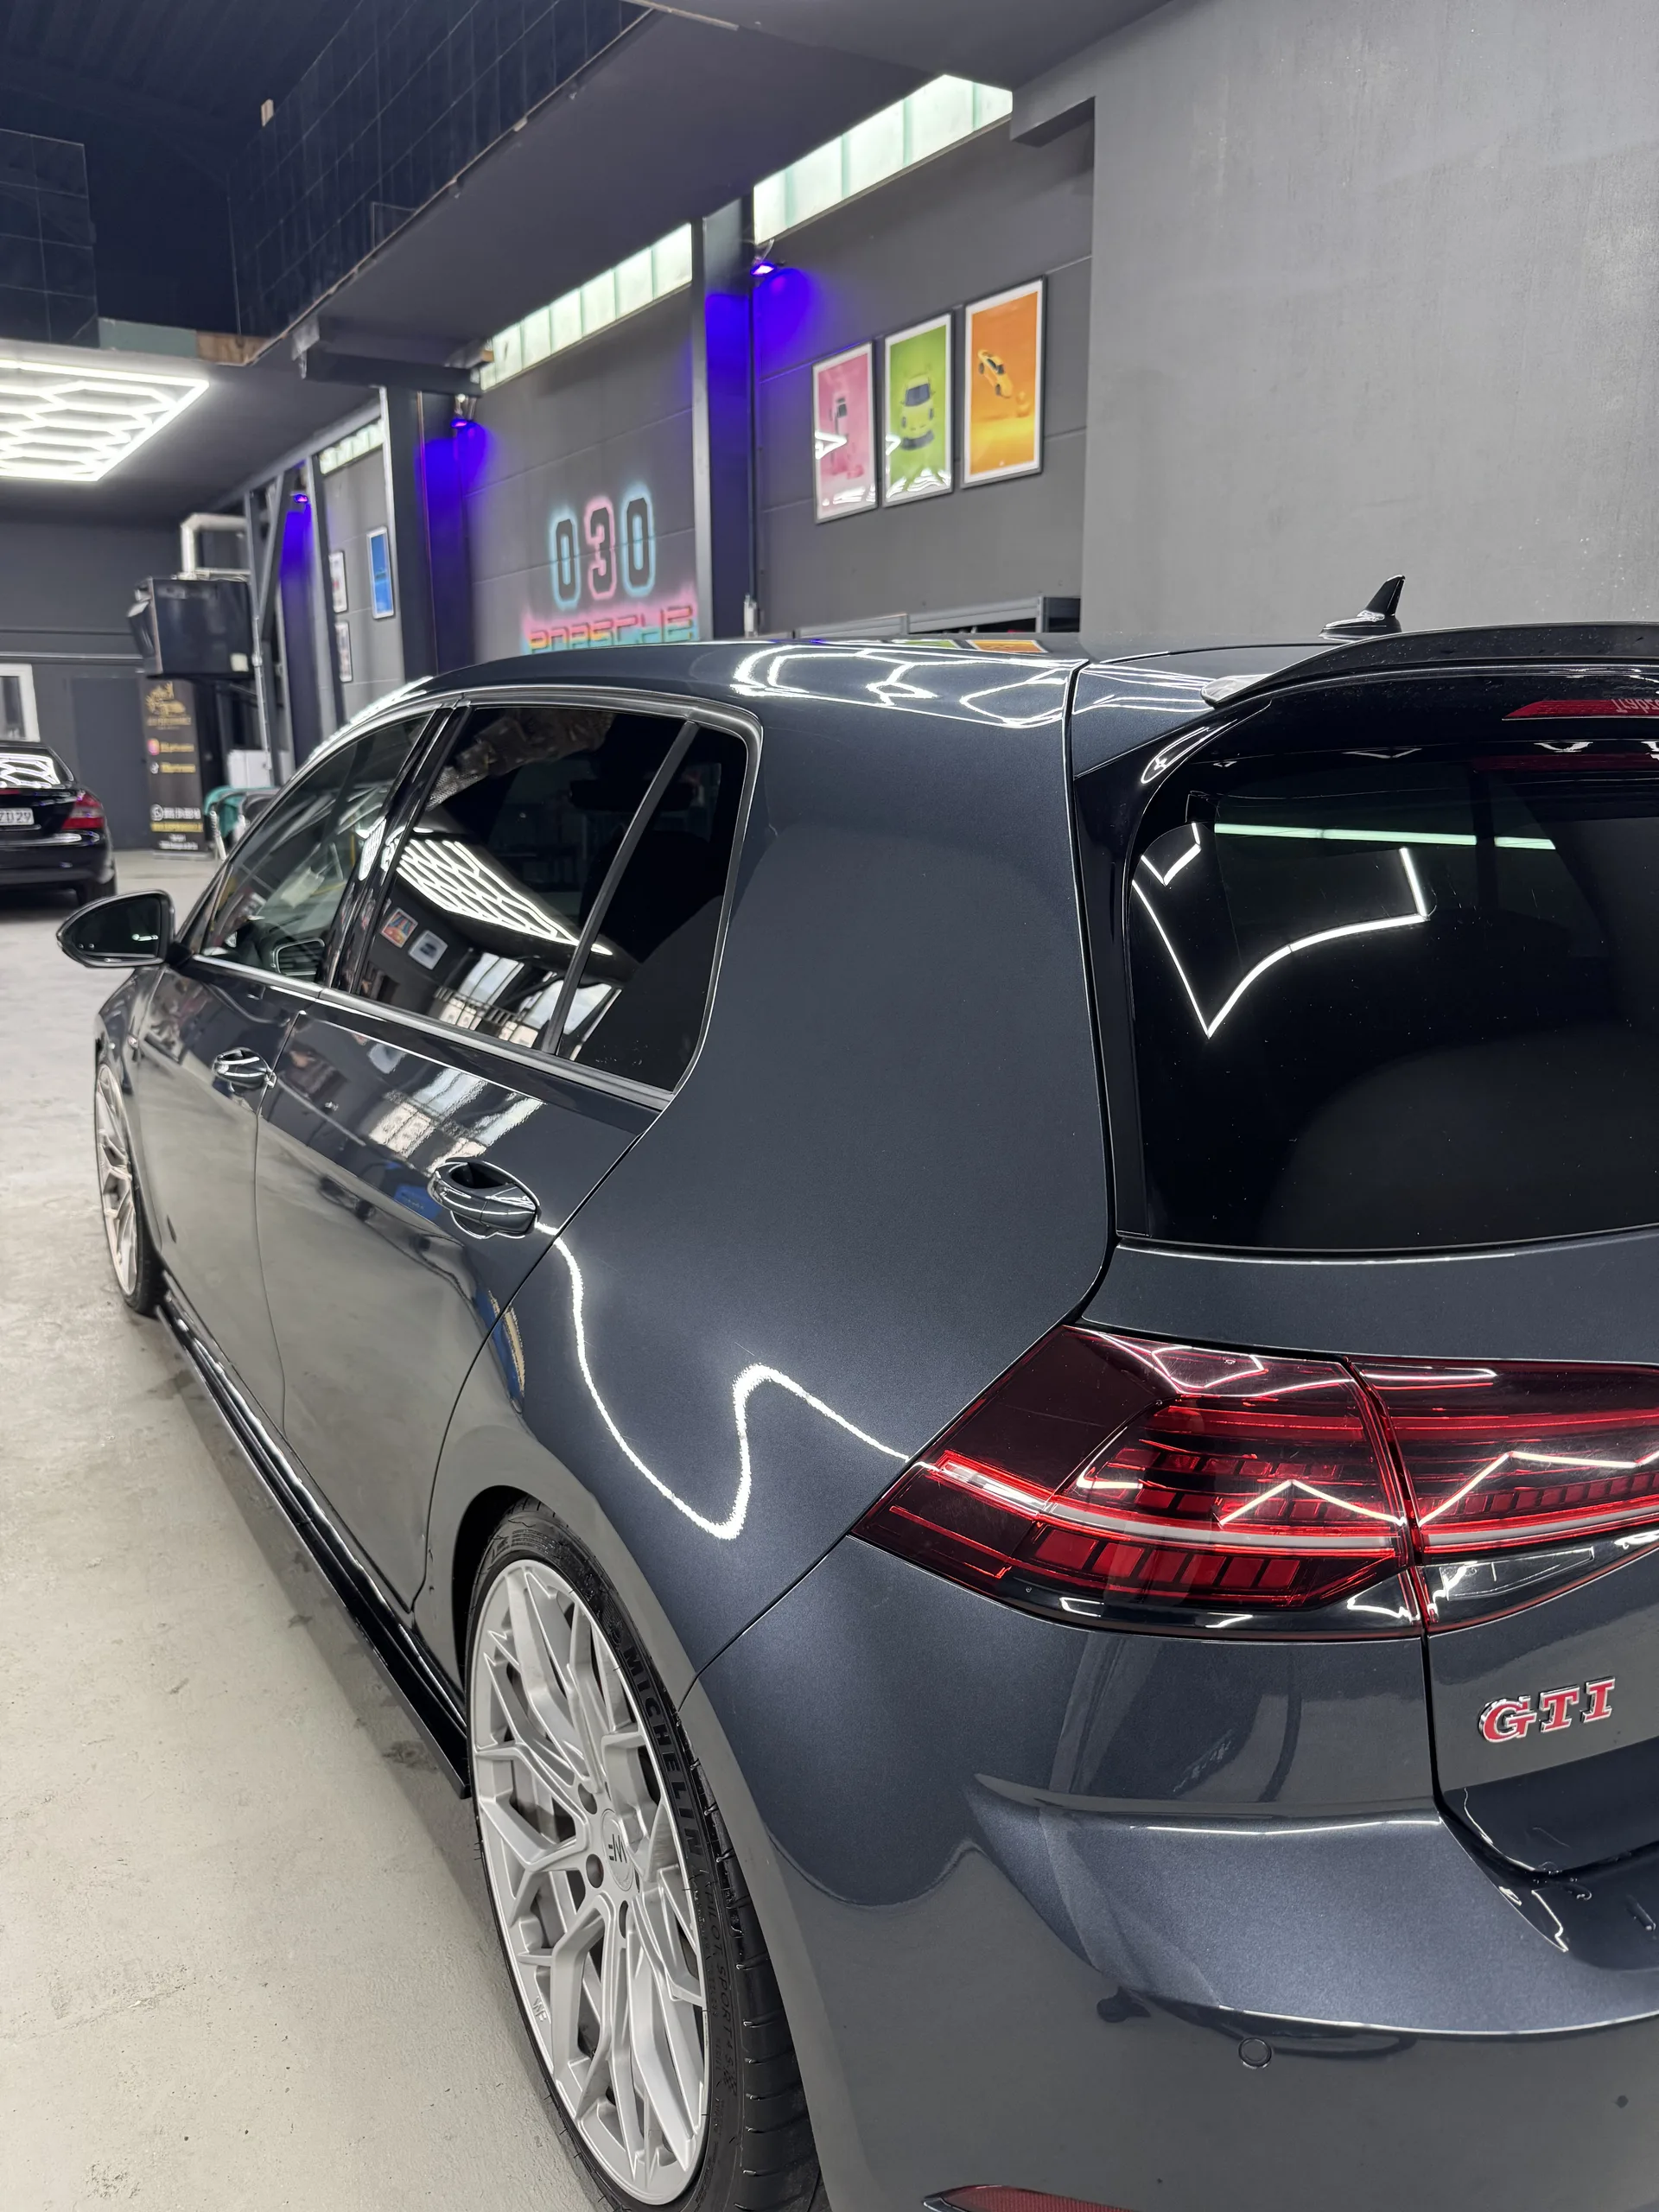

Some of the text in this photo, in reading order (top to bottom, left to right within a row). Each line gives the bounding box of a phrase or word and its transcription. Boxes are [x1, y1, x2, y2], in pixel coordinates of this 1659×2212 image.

[550, 492, 656, 606] 030
[621, 1645, 702, 1856] MICHELIN
[1478, 1676, 1616, 1743] GTI
[704, 1890, 724, 1955] PILOT
[715, 1964, 734, 2036] SPORT
